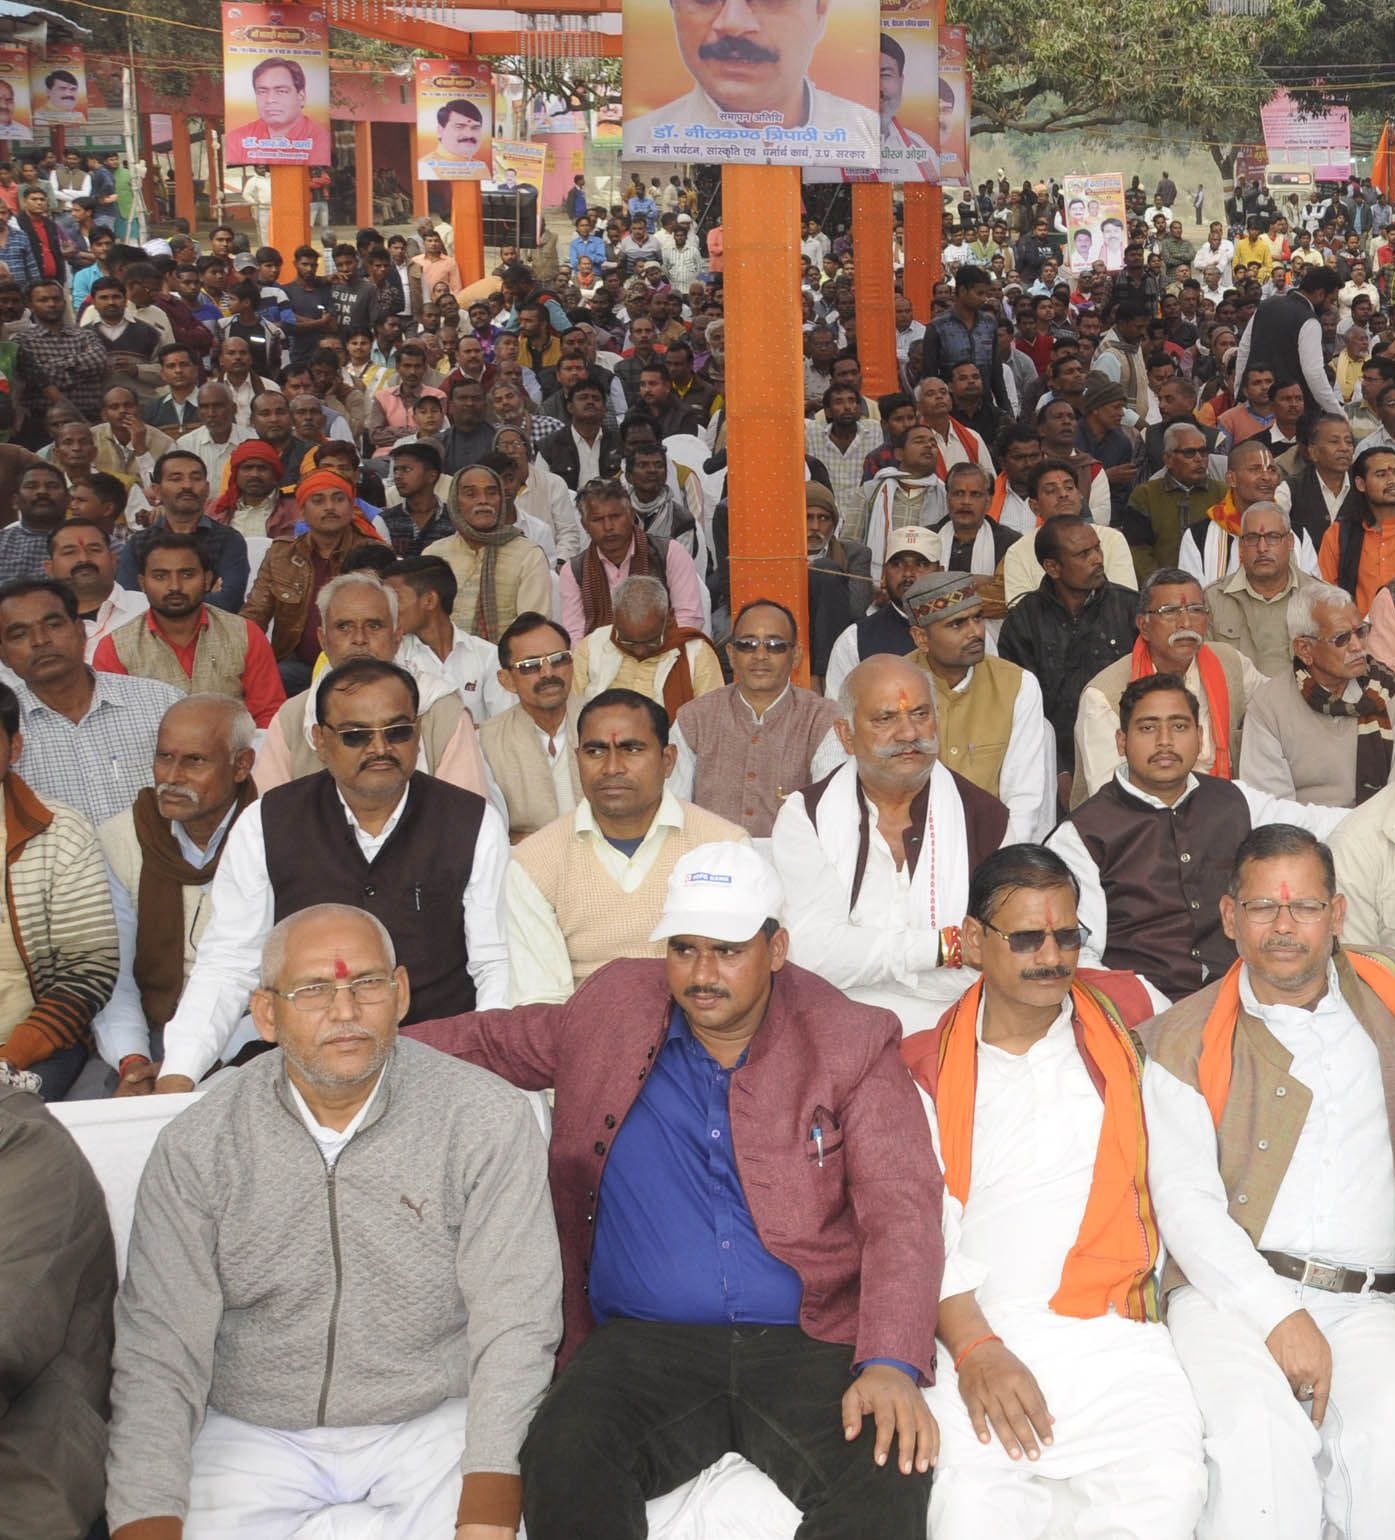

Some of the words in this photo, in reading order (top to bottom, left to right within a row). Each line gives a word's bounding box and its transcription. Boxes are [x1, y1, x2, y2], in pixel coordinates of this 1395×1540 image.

[653, 124, 679, 139] डॉ.
[684, 124, 761, 140] नीलकण्ठ
[765, 126, 817, 141] त्रिपाठी
[823, 127, 847, 142] जी
[332, 291, 358, 303] RUN
